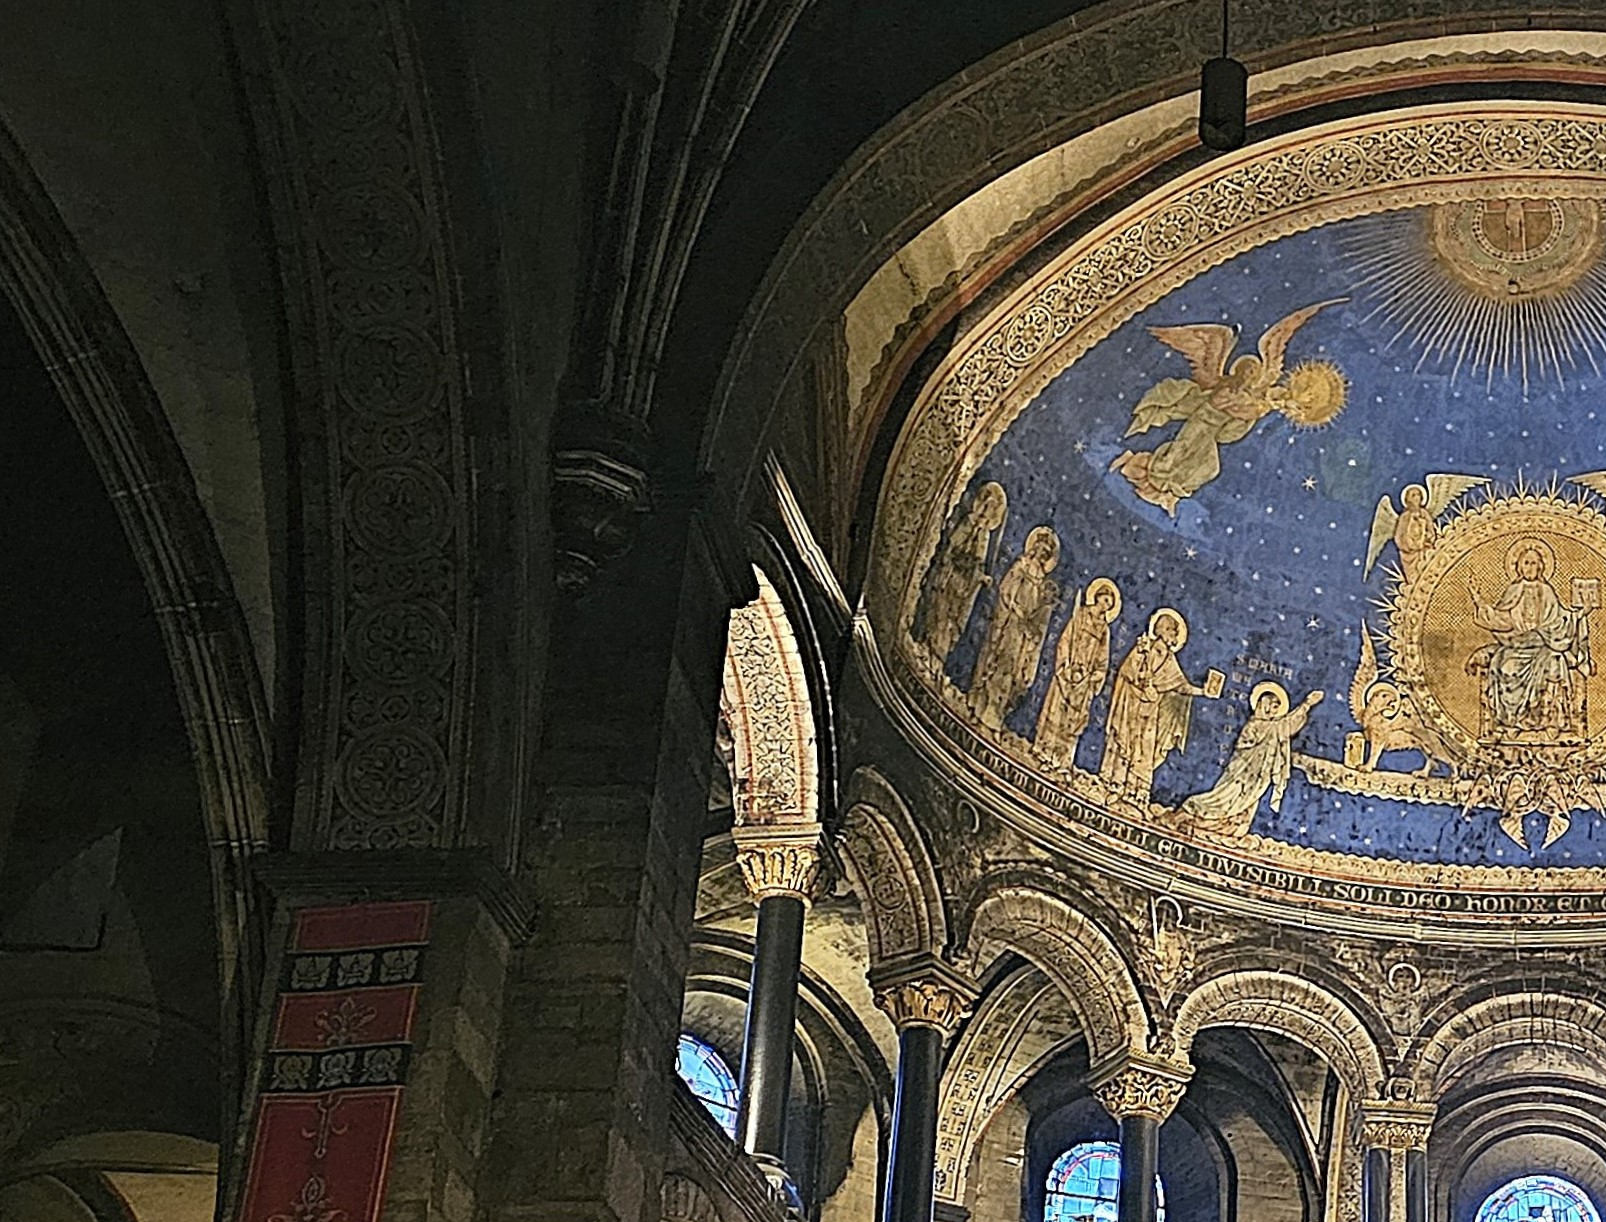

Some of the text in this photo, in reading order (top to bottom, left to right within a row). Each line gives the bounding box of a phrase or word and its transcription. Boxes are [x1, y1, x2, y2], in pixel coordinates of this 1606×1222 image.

[1157, 838, 1191, 861] ET
[1332, 882, 1393, 907] SOLI
[1400, 889, 1451, 911] DEO
